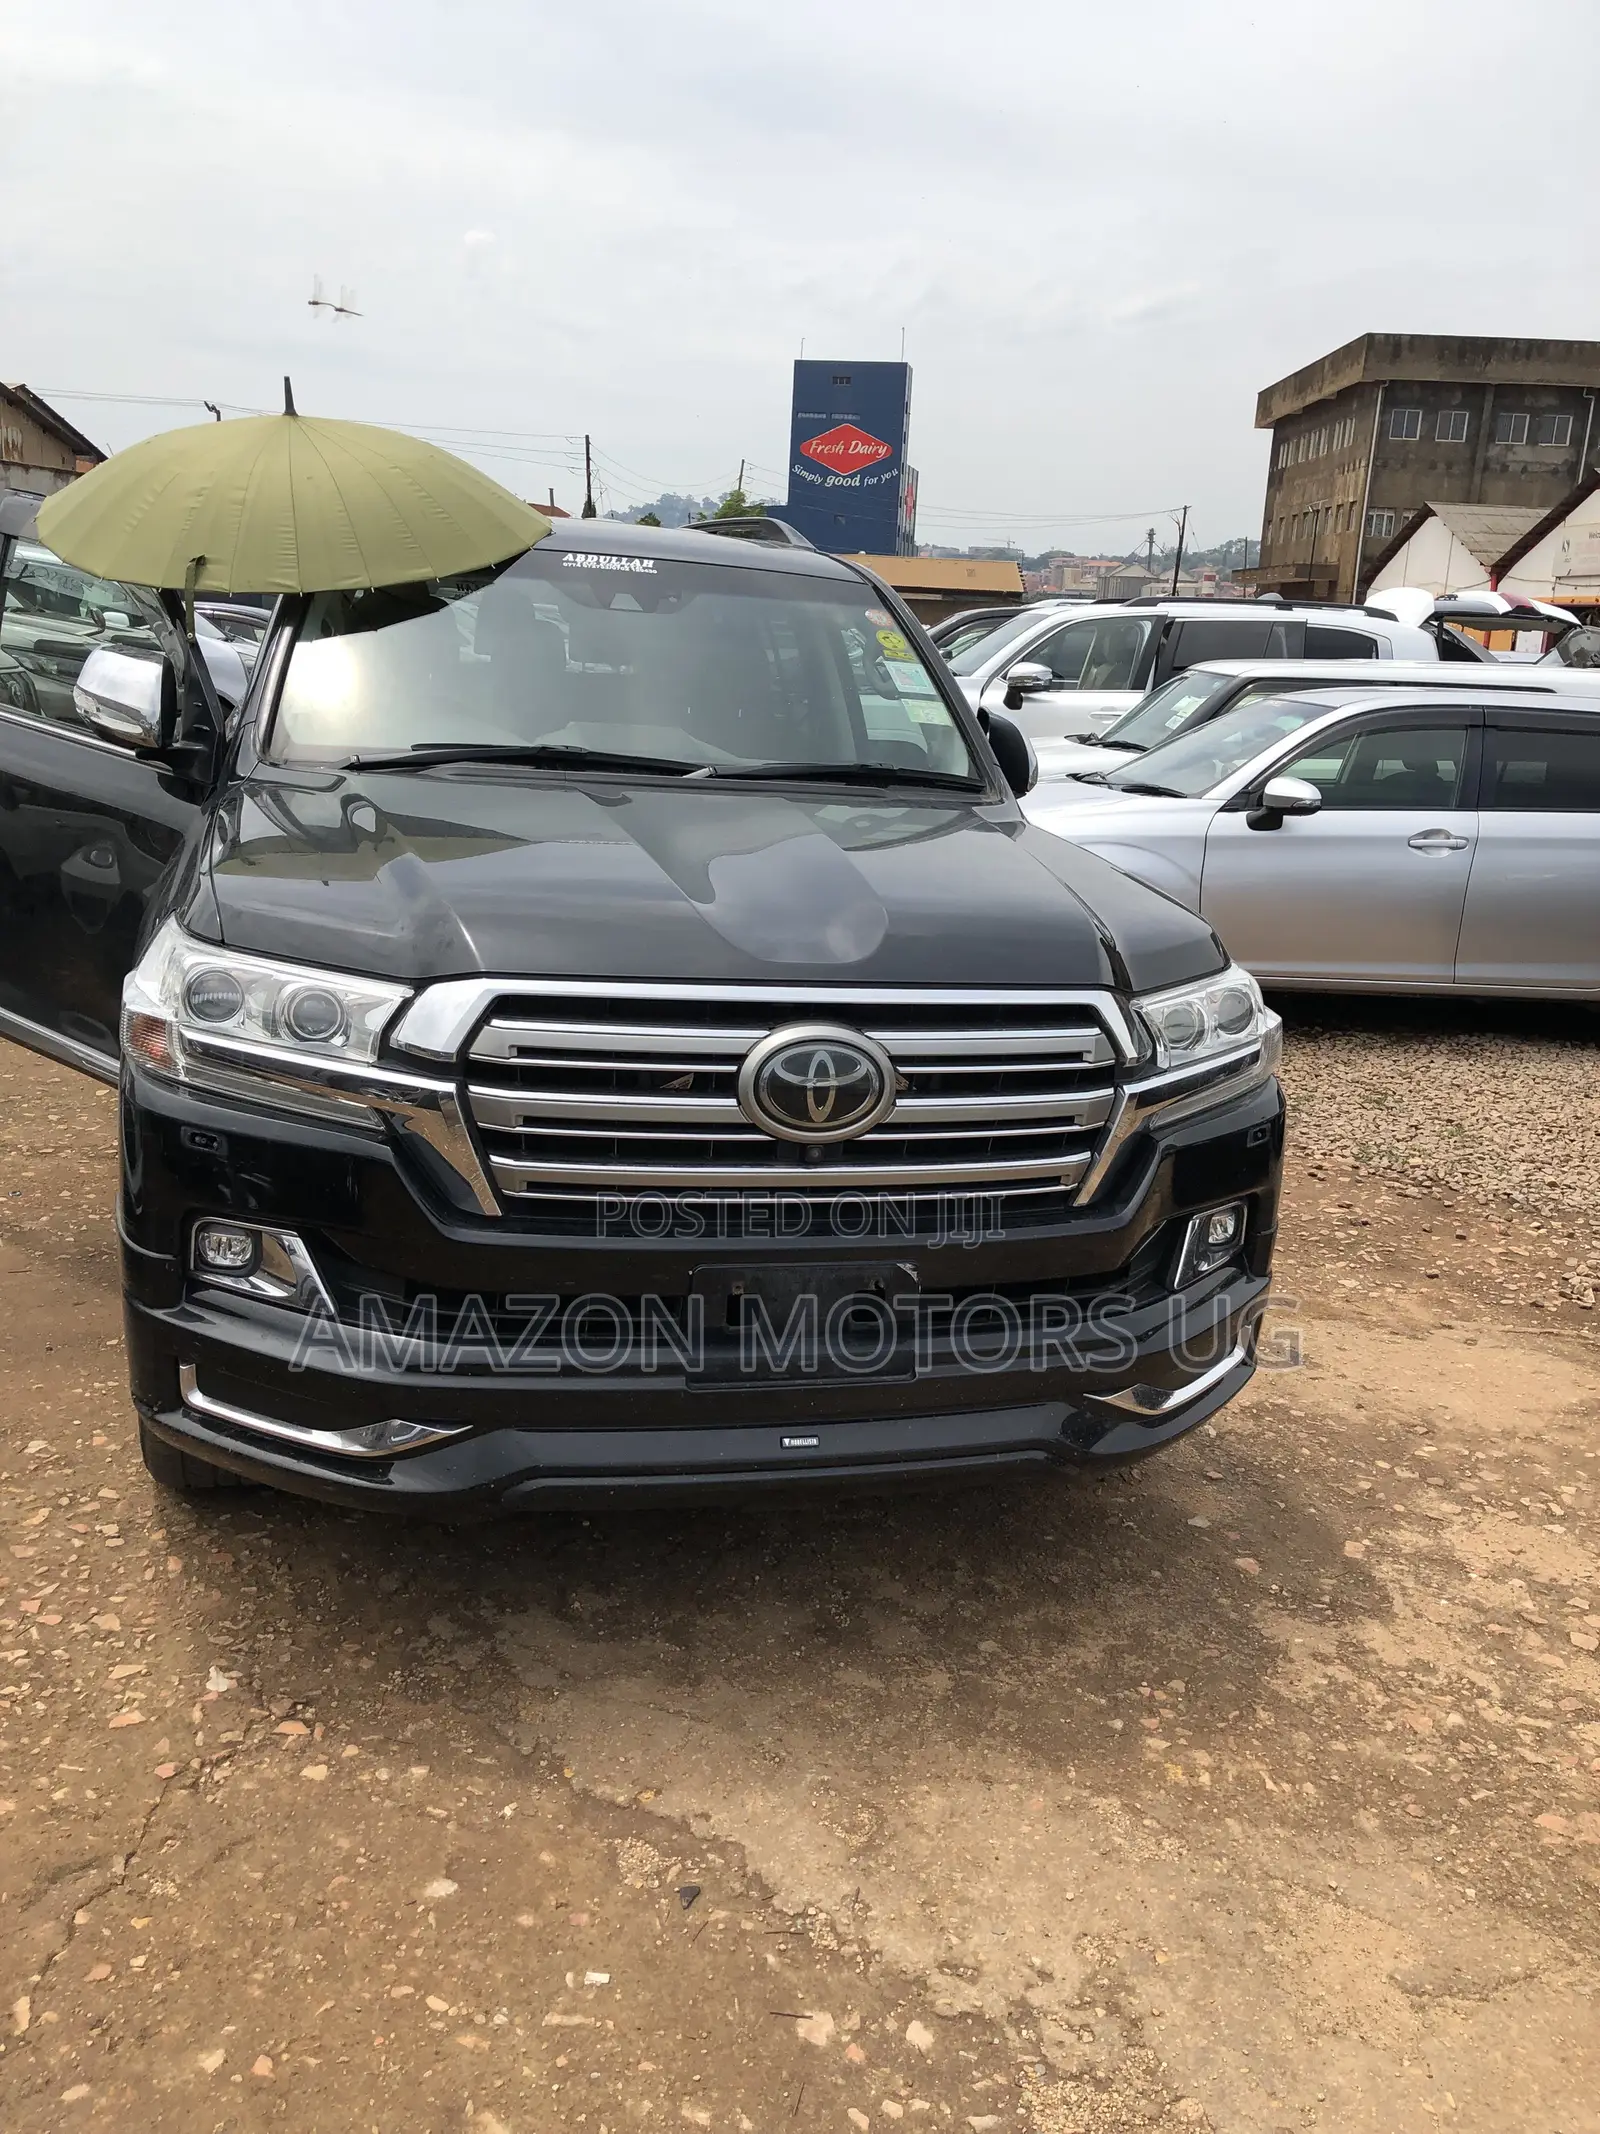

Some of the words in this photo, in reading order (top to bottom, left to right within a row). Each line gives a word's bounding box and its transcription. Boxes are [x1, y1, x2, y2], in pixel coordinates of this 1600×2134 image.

[809, 440, 845, 456] Fresh
[848, 440, 888, 459] Dairy
[791, 464, 824, 485] Simply
[824, 474, 861, 488] good
[863, 476, 879, 488] for
[880, 468, 899, 484] you
[562, 553, 655, 569] ABDULLAH
